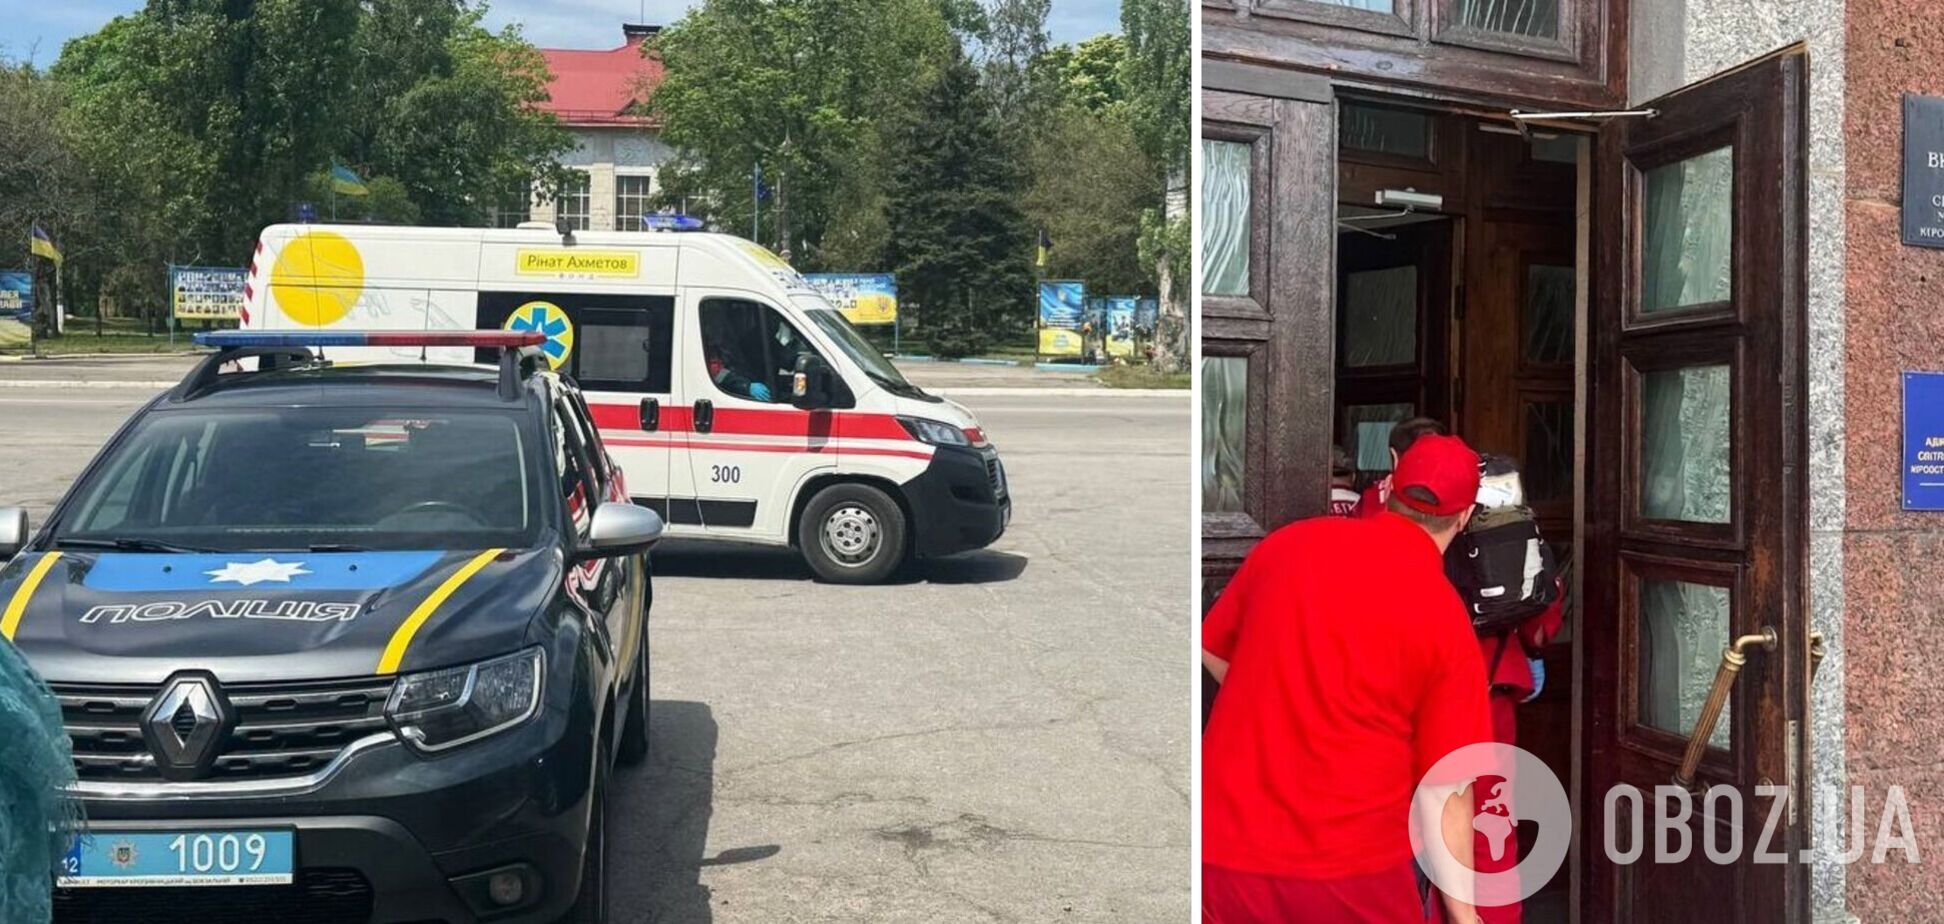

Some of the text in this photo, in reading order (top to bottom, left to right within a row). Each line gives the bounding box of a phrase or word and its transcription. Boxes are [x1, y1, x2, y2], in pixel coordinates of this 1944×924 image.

[527, 254, 628, 270] Рінат Ахметов
[711, 464, 741, 484] 300
[79, 599, 361, 623] ПОЛІЦІЯ
[169, 833, 266, 872] 1009
[61, 856, 79, 873] 12
